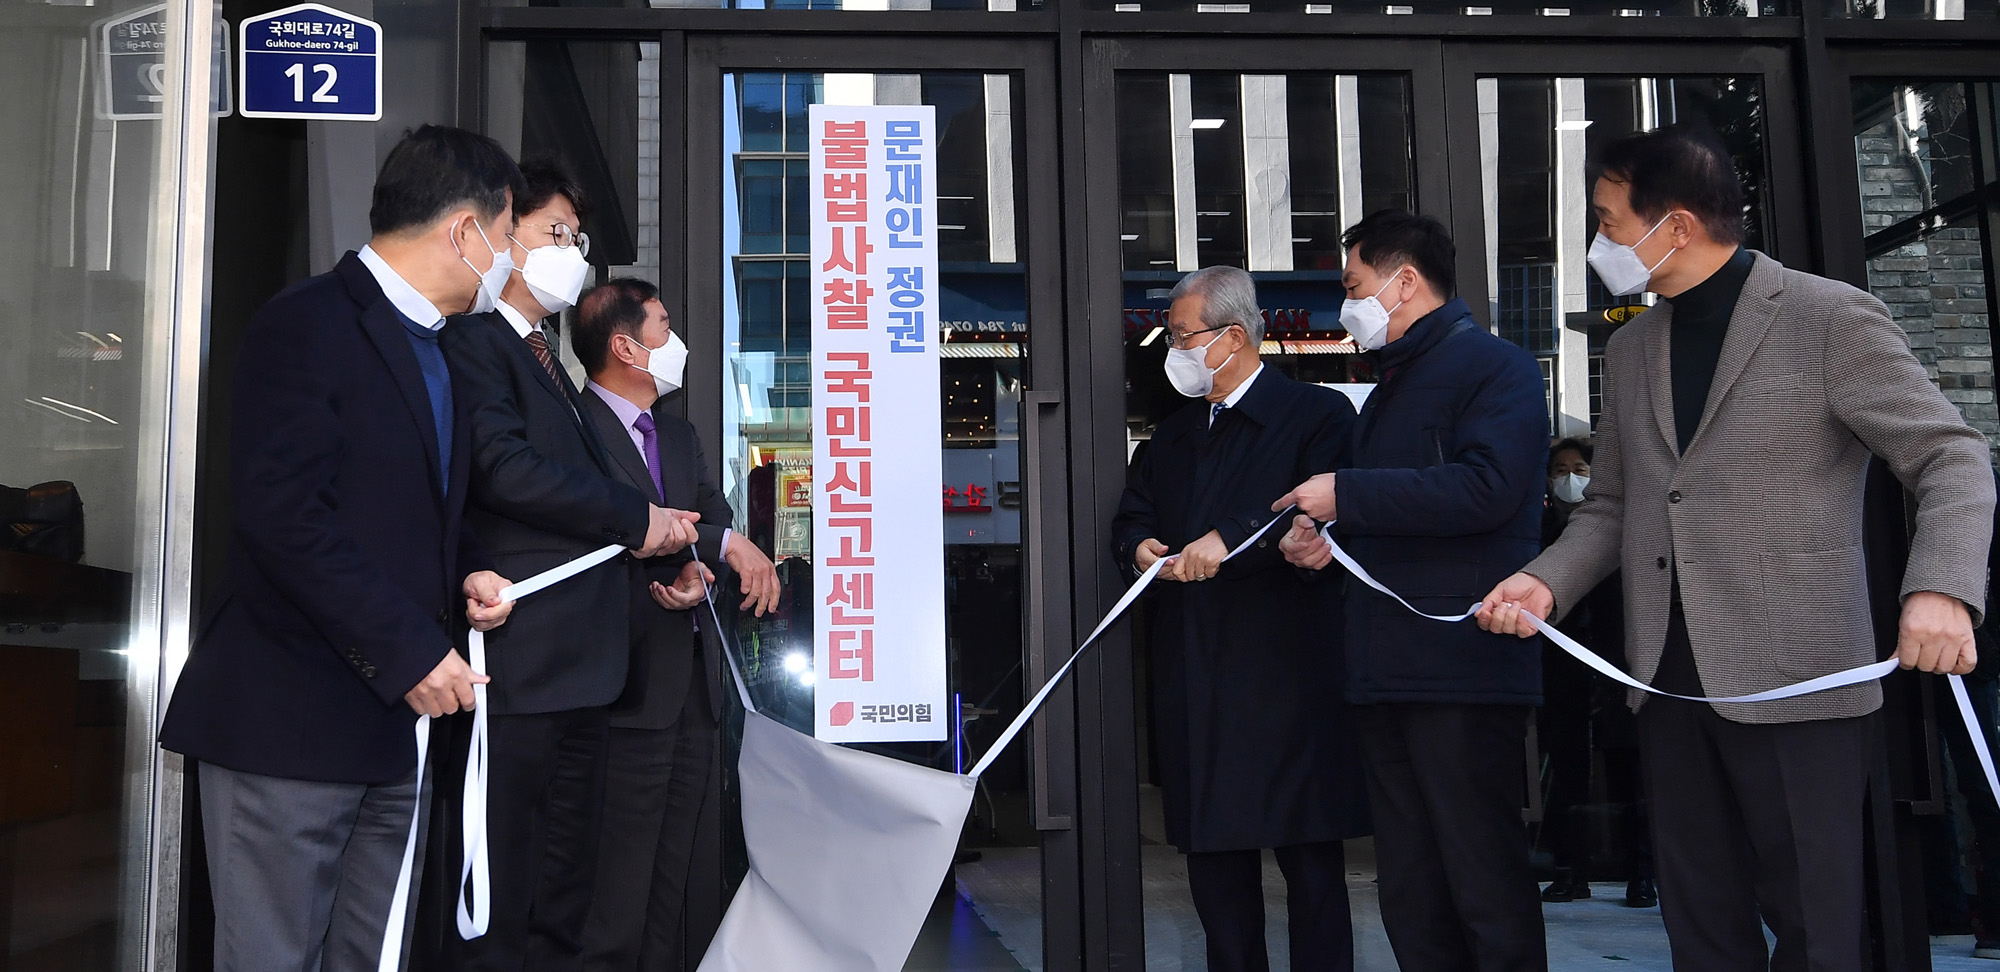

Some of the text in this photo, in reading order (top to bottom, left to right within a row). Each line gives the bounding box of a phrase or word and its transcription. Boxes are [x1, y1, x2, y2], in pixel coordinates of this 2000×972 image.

[268, 20, 356, 40] 국회대로74길
[265, 39, 359, 52] Gukhoe-daero 74-gil
[284, 63, 339, 104] 12
[883, 120, 926, 354] 문재인 정권
[821, 120, 875, 683] 불법사찰 국민신고센터
[860, 703, 932, 723] 국민의힘
